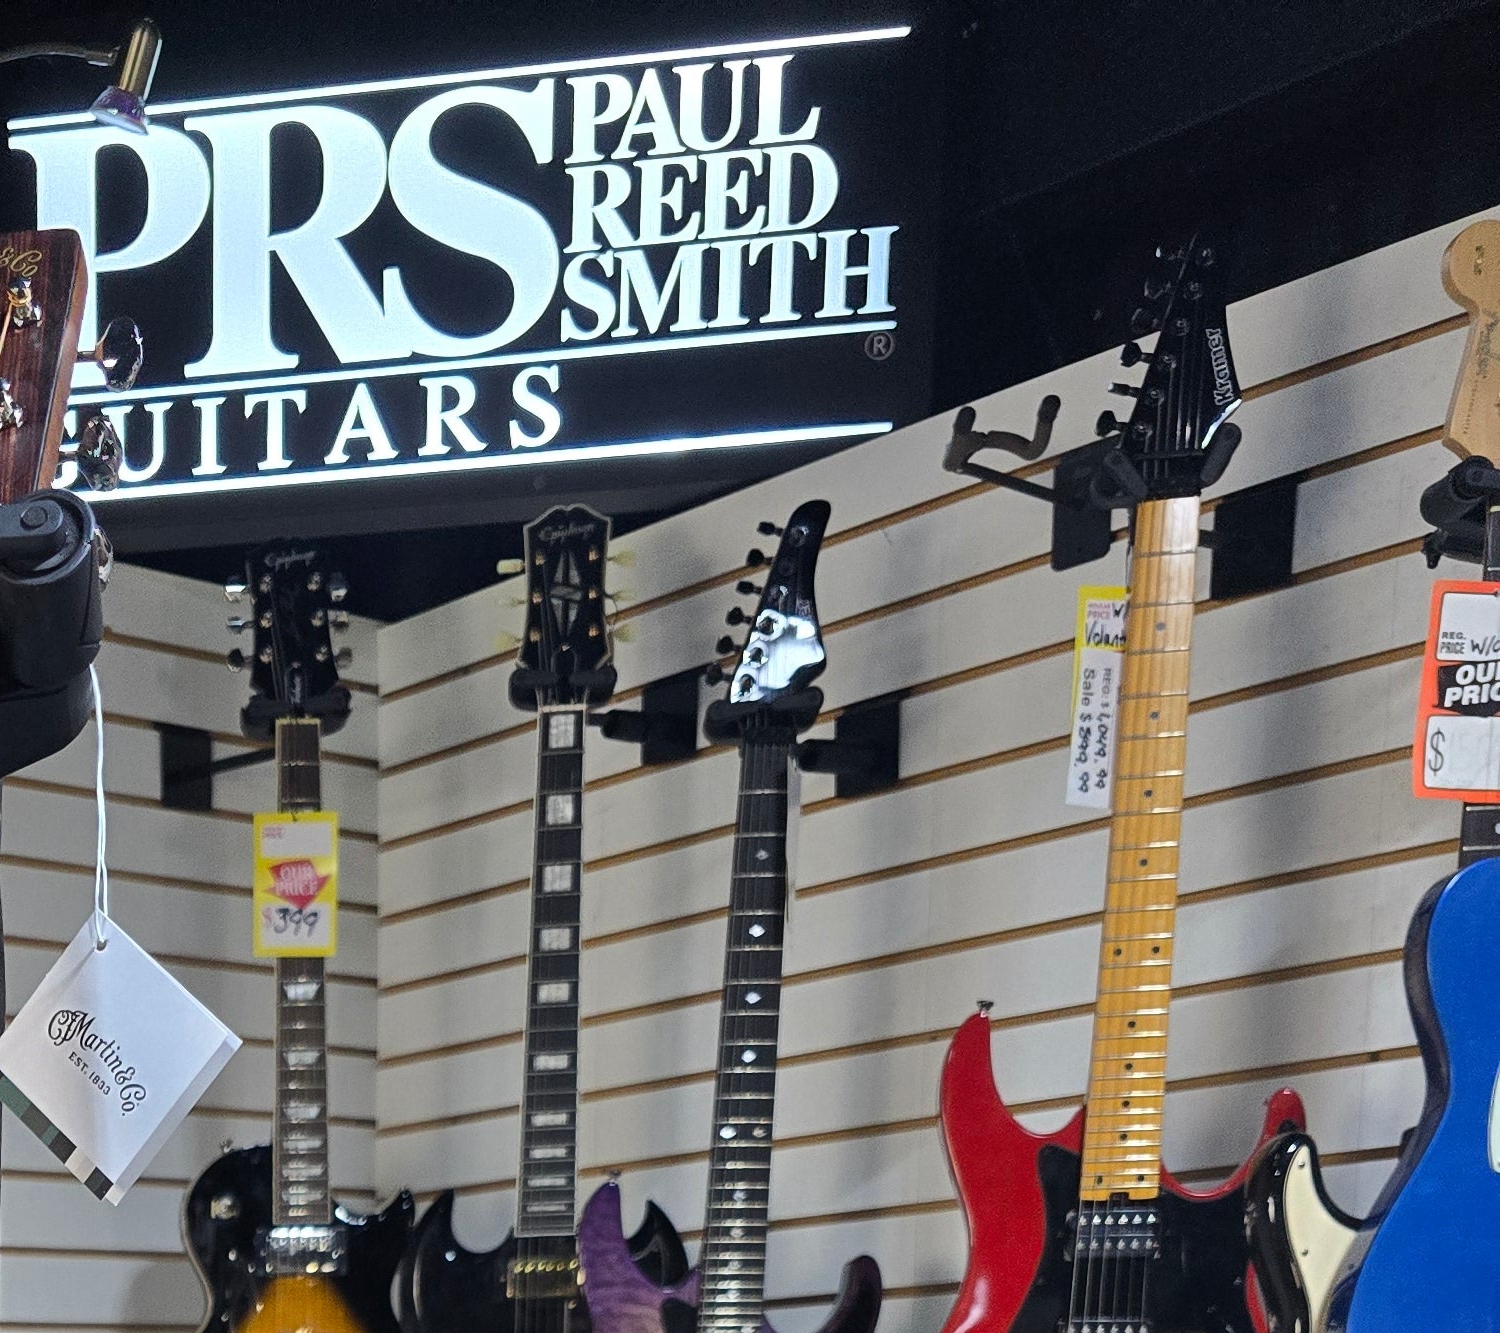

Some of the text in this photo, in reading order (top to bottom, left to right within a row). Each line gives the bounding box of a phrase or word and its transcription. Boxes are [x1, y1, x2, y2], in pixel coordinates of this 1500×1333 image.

[566, 55, 820, 166] PAUL
[8, 78, 560, 378] PRS
[566, 143, 840, 254] REED
[561, 225, 900, 344] SMITH
[1205, 328, 1235, 406] Kramer
[1081, 668, 1095, 707] Sale
